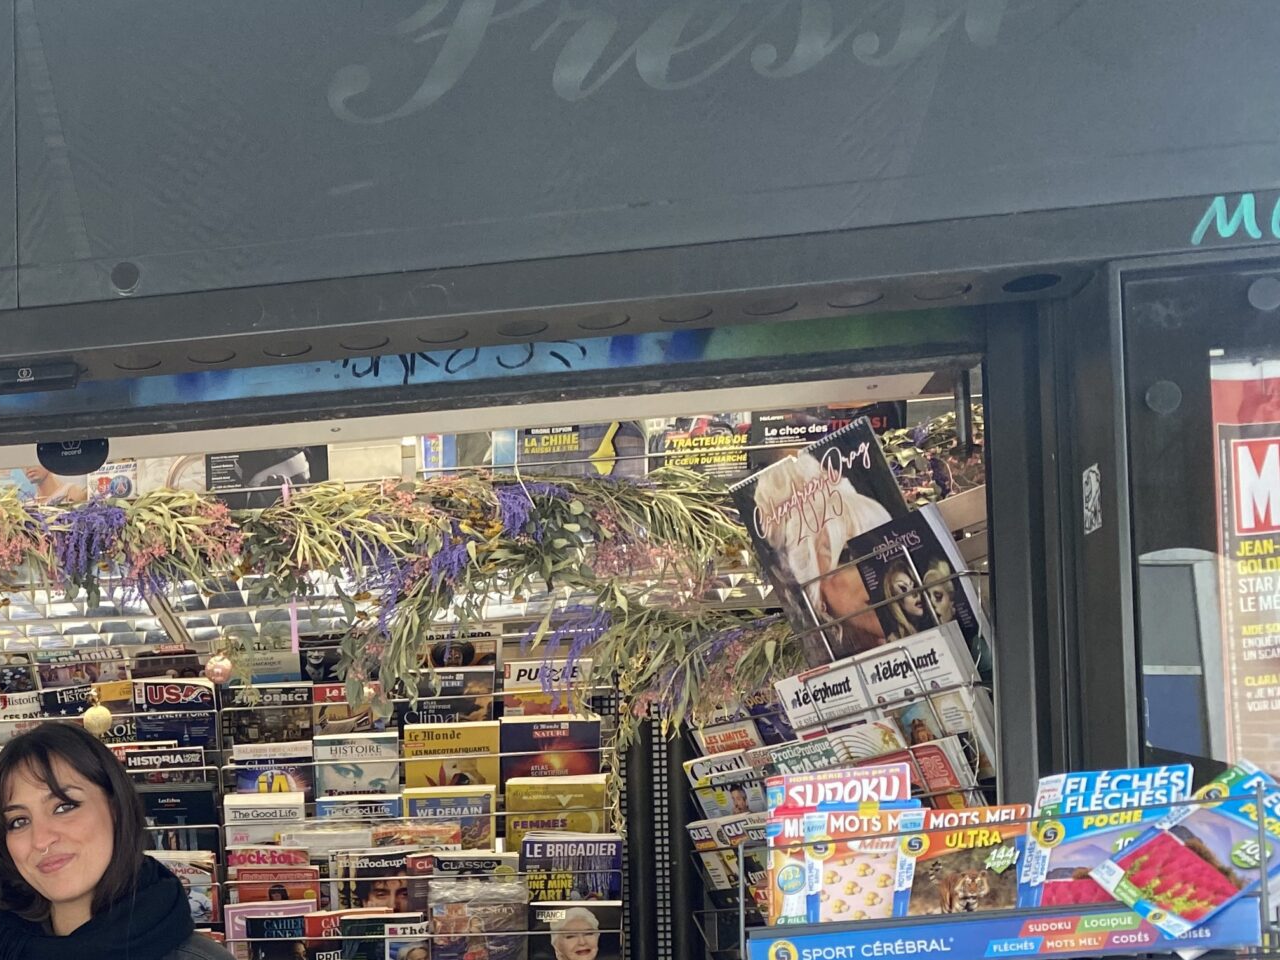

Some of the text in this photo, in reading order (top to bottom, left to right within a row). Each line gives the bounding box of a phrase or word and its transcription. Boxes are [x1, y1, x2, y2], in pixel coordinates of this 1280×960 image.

[765, 427, 778, 436] Le
[780, 427, 806, 436] choc
[808, 424, 829, 434] des
[524, 434, 580, 447] LA CHINE
[673, 434, 748, 447] TRACTEURS DE
[702, 453, 747, 465] DU MARCHÉ
[821, 441, 870, 485] Drag
[1238, 577, 1274, 594] STAR
[1239, 596, 1256, 613] LE
[1243, 649, 1255, 661] UN
[1244, 675, 1276, 687] CLARA
[1246, 699, 1268, 712] VOIR
[408, 729, 462, 742] Le Monde
[533, 729, 570, 738] NATURE
[720, 729, 749, 744] LIMITES
[329, 744, 383, 755] HISTOIRE
[423, 745, 491, 757] NARCOTRAFIQUANTS
[127, 754, 184, 767] HISTORIA
[788, 776, 901, 807] SUDOKU
[1066, 789, 1169, 815] FLÉCHÉS
[232, 808, 297, 820] The Good Life
[325, 804, 391, 817] The Good Life
[416, 806, 483, 818] WE DEMAIN
[513, 818, 568, 830] FEMMES
[830, 815, 881, 833] MOTS
[929, 810, 980, 830] MOTS
[1083, 809, 1143, 830] POCHE
[945, 828, 1004, 849] ULTRA
[525, 842, 617, 858] LE BRIGADIER
[990, 847, 1015, 861] 144
[441, 860, 499, 871] CLASSICA
[536, 910, 566, 920] FRANCE
[1028, 916, 1133, 933] SUDOKU LOGIQUE
[861, 938, 950, 958] CÉRÉBRAL
[992, 932, 1150, 952] FLÉCHÉS MOTS MEL' CODÉS
